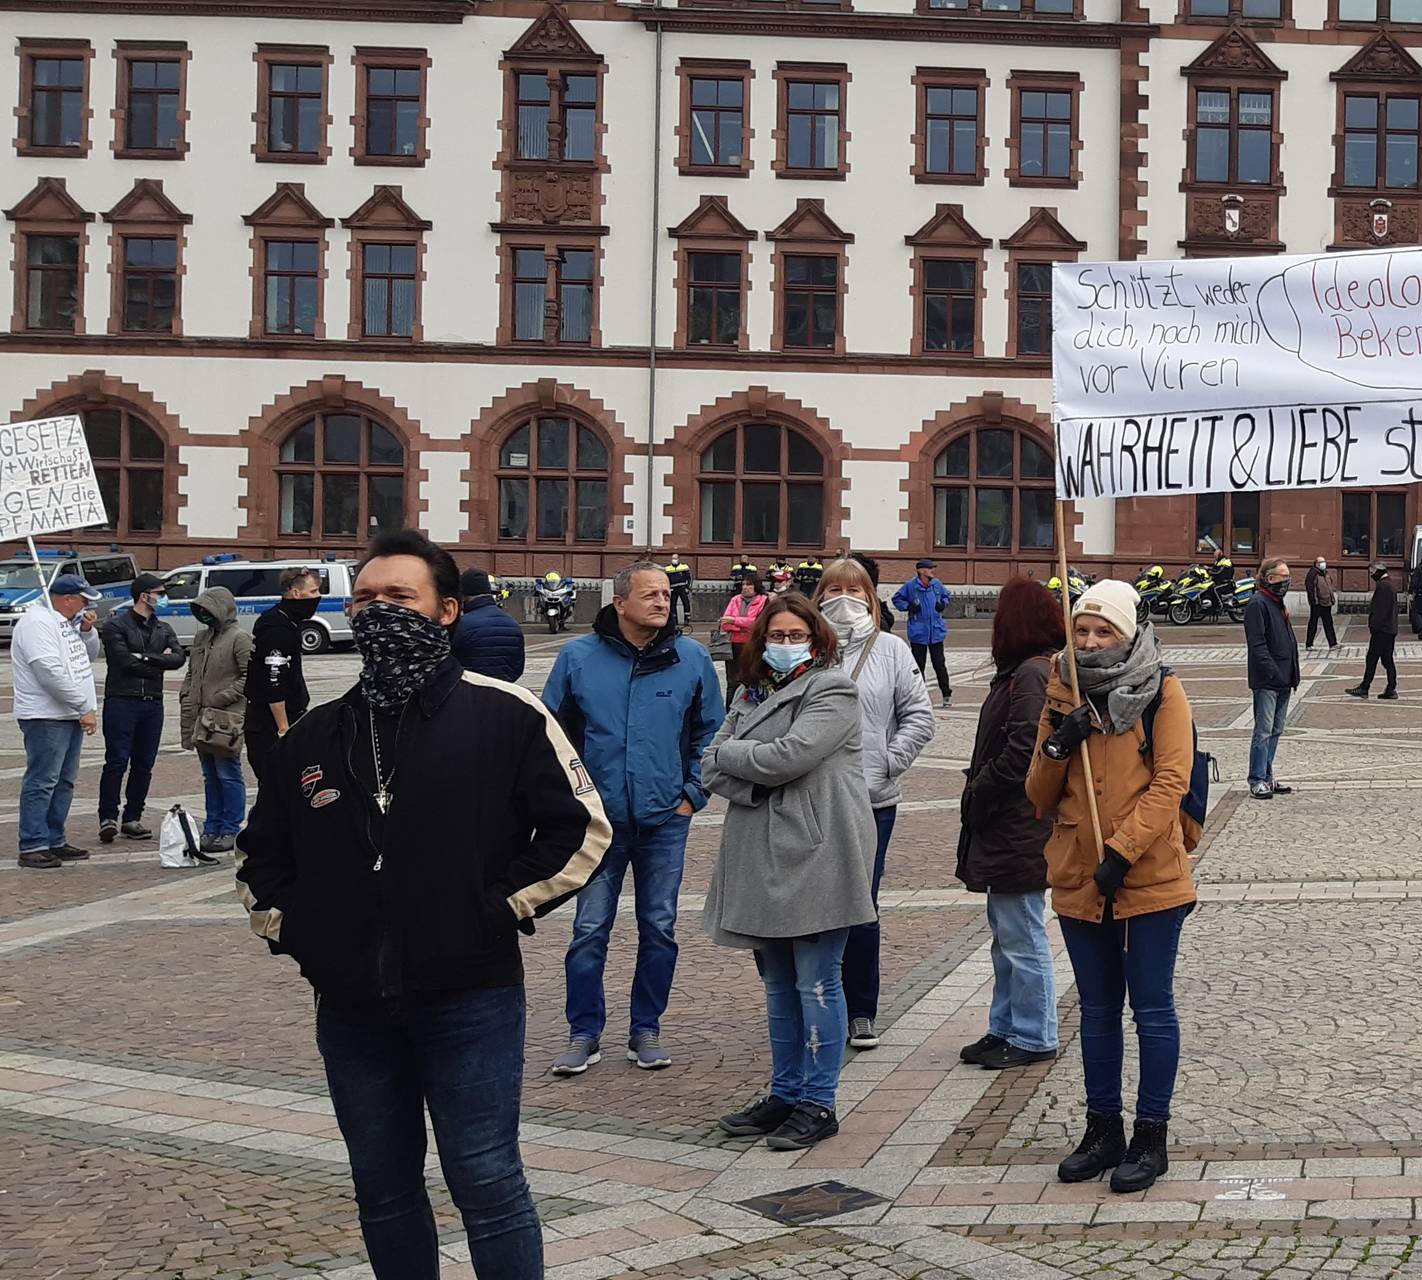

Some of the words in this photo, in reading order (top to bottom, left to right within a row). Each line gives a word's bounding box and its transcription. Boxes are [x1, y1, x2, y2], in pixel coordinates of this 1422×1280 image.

[1077, 265, 1196, 310] Schützt
[1195, 264, 1252, 307] weder
[1073, 310, 1139, 350] dich,
[1148, 309, 1201, 346] noch
[1214, 306, 1261, 346] mich
[1079, 363, 1129, 394] vor
[1140, 346, 1239, 392] Viren
[30, 461, 91, 486] RETTEN
[1056, 415, 1224, 499] WAHRHEIT
[1264, 405, 1362, 487] LIEBE
[71, 483, 96, 503] die
